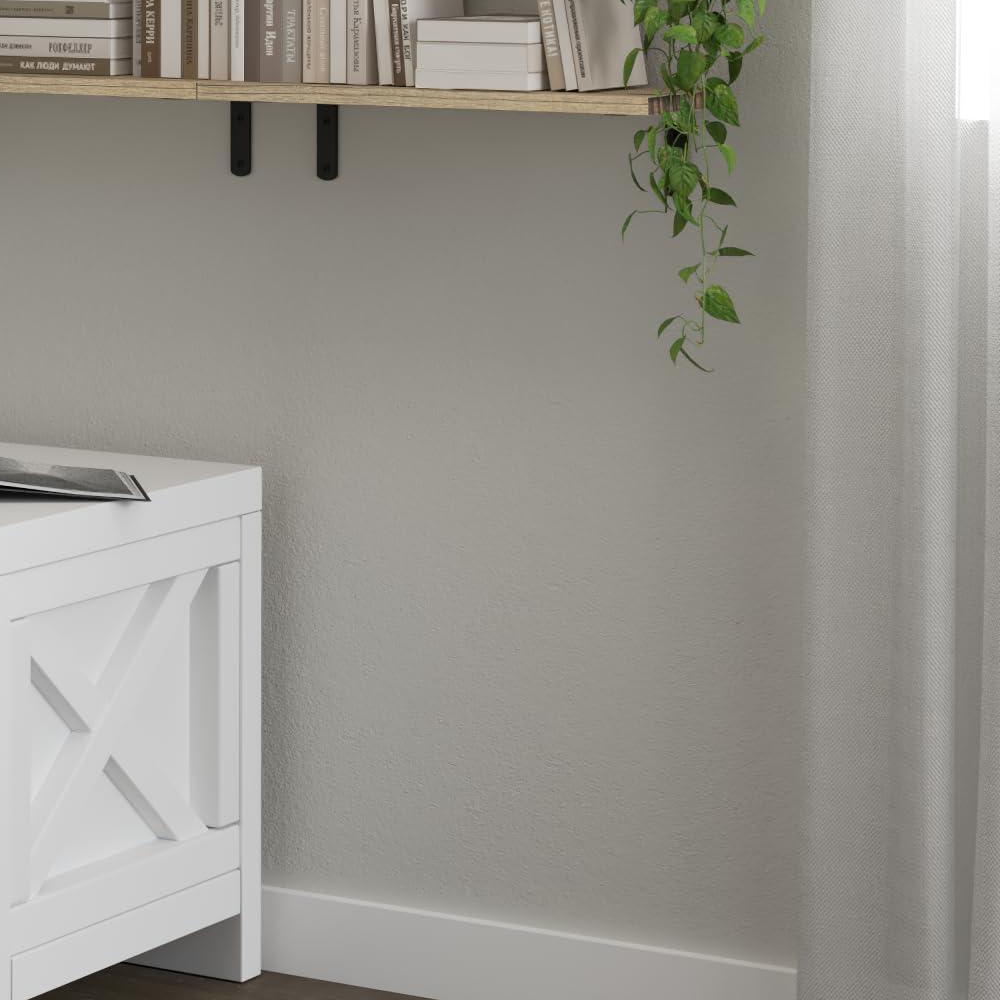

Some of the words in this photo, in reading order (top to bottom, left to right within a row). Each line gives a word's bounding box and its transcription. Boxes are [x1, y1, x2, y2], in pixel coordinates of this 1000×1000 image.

[145, 11, 155, 44] КЕРРИ
[265, 30, 276, 57] Иден
[20, 60, 36, 70] КАК
[36, 60, 60, 71] ЛЮДИ
[62, 61, 96, 71] ДУМАЮТ
